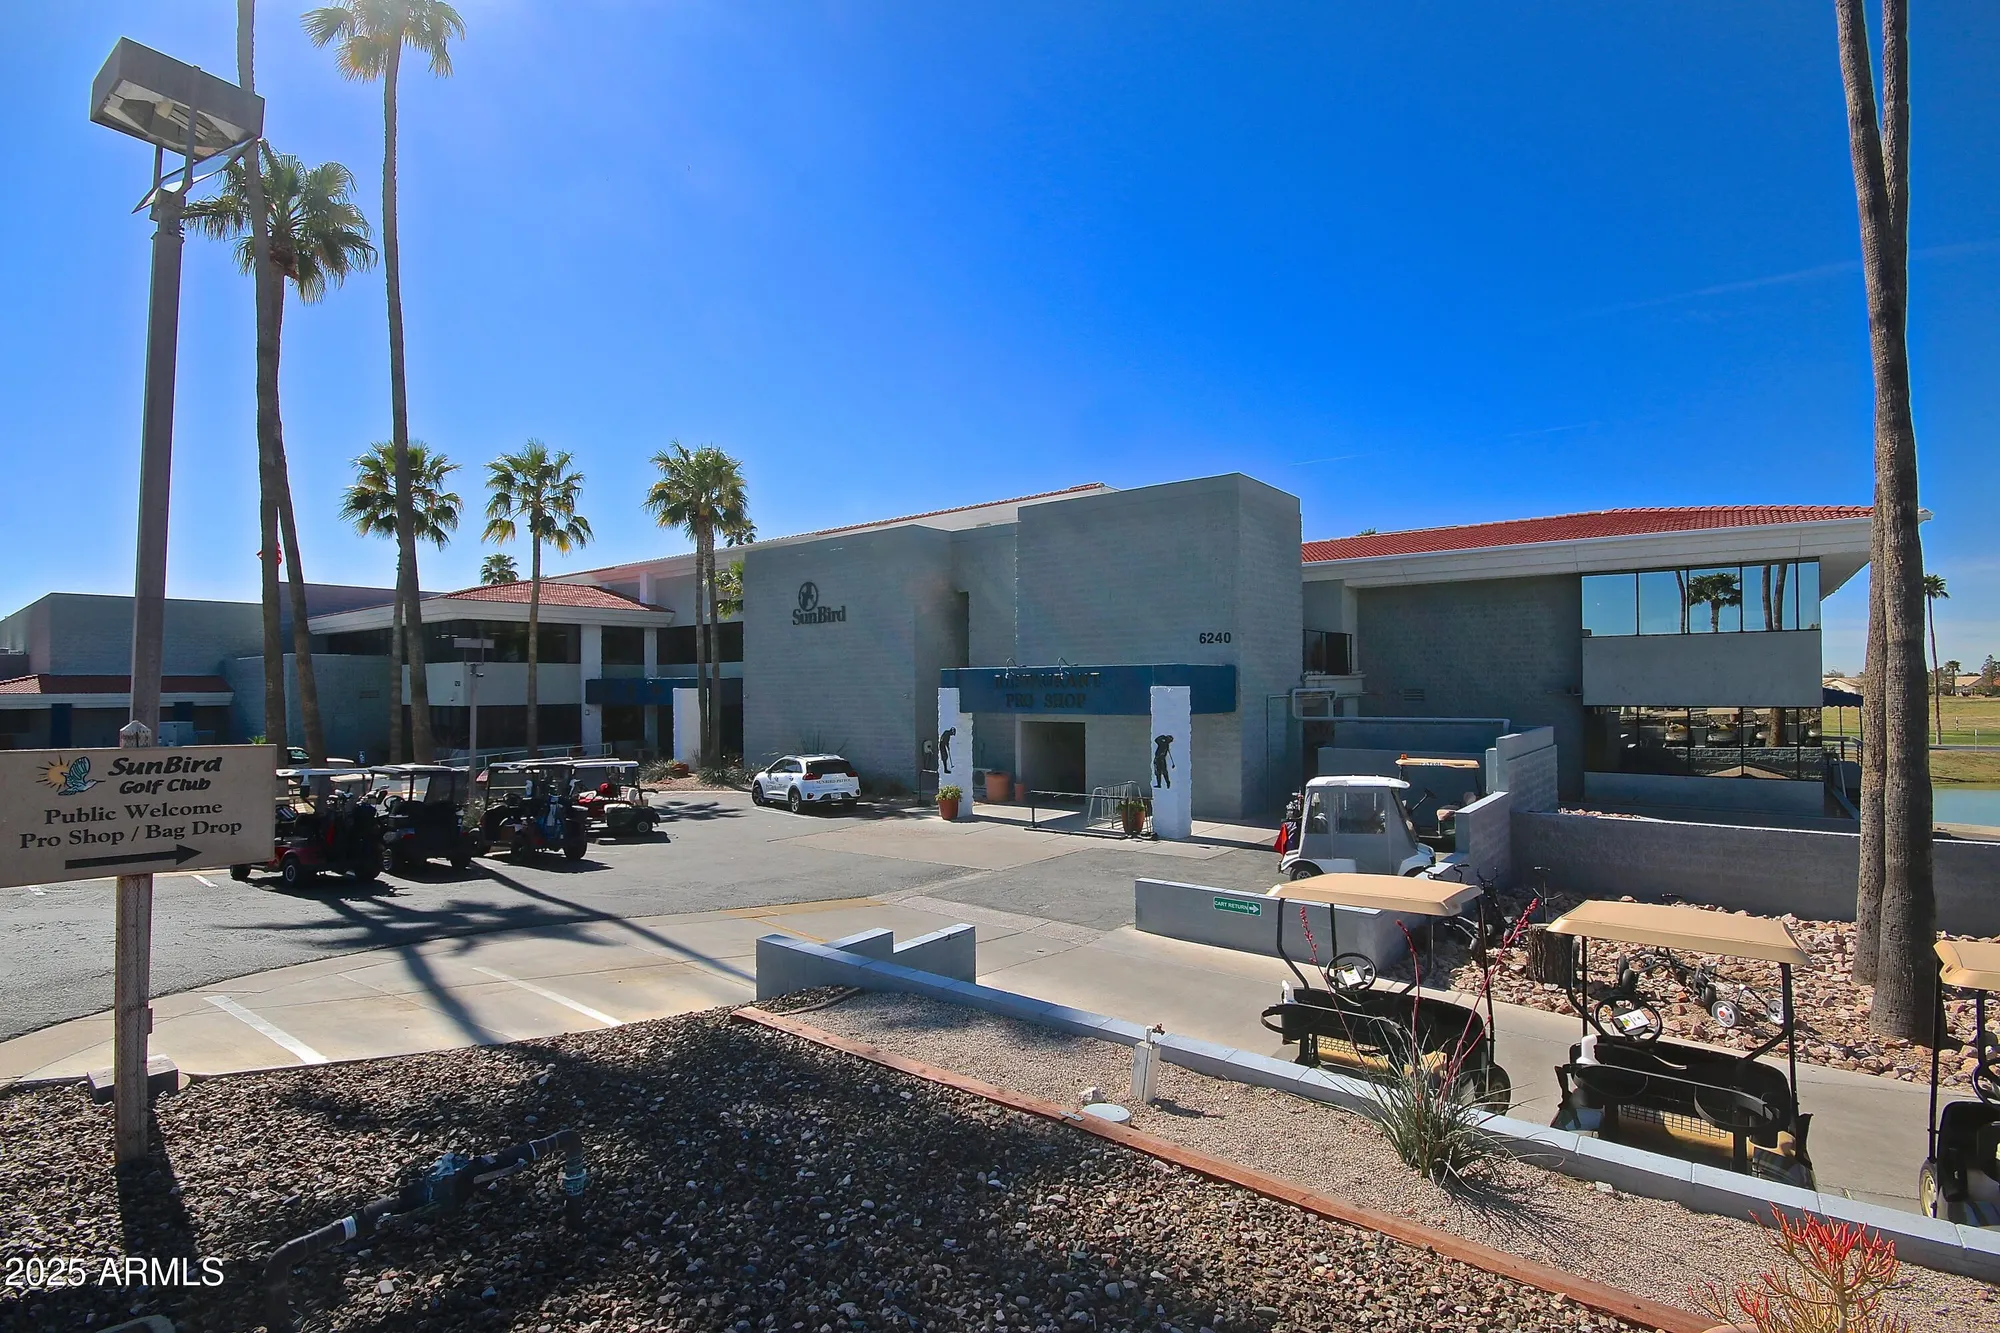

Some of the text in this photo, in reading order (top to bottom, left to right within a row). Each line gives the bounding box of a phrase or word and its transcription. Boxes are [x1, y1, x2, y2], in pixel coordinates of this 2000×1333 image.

[792, 605, 846, 626] SunBird
[1199, 632, 1231, 644] 6240
[1005, 693, 1087, 709] PRO SHOP
[108, 755, 223, 776] SunBird
[119, 777, 212, 795] Golf Club
[44, 802, 223, 825] Public Welcome
[19, 820, 242, 849] Pro Shop / Bag Drop
